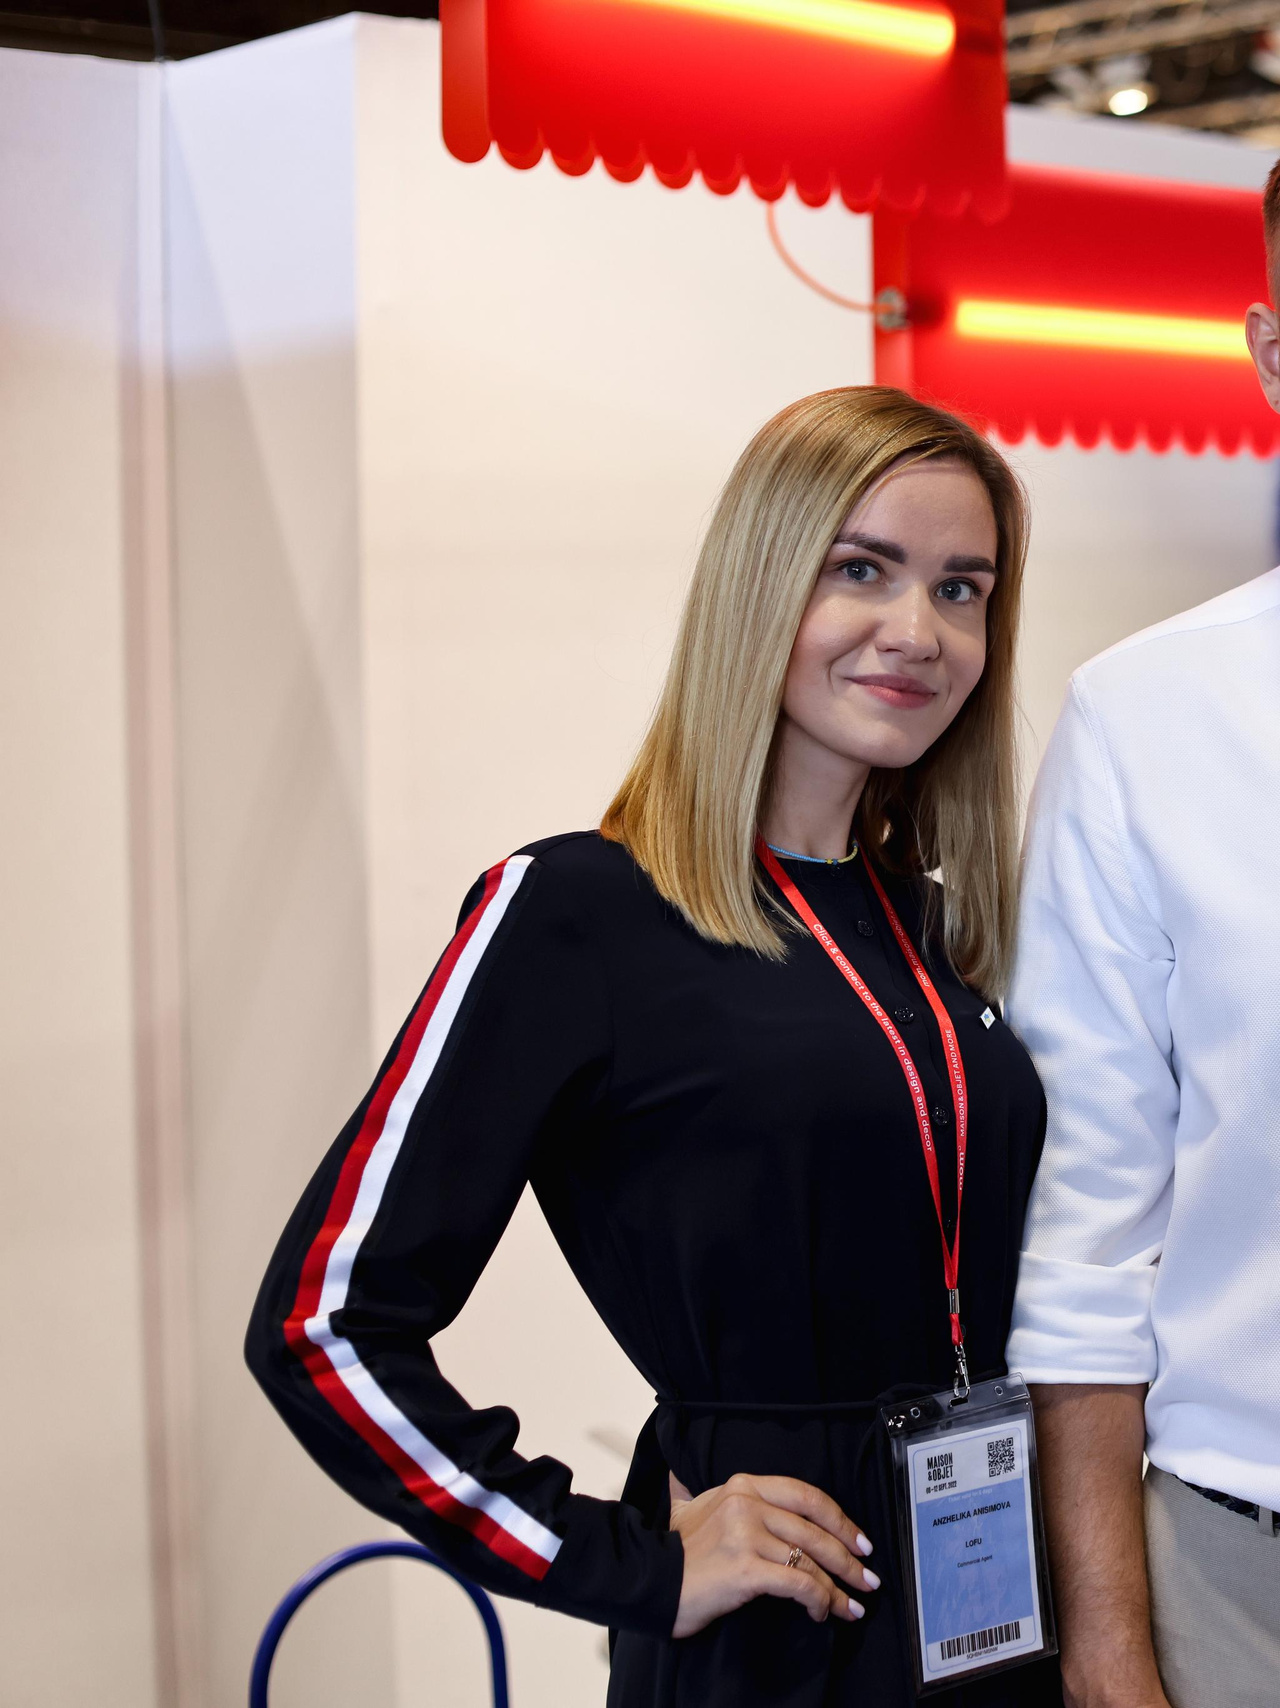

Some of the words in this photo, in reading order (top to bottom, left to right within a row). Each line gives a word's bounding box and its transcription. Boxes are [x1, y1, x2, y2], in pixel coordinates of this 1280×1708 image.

[813, 923, 833, 946] Click
[830, 946, 839, 955] &
[835, 955, 865, 990] connect
[862, 991, 872, 1001] to
[870, 1002, 883, 1017] the
[881, 1017, 901, 1044] latest
[945, 1029, 955, 1051] MORE
[897, 1046, 906, 1056] in
[950, 1051, 959, 1069] AND
[903, 1058, 921, 1094] design
[954, 1070, 963, 1095] OBJET
[916, 1096, 928, 1117] and
[921, 1119, 933, 1152] decor
[927, 1452, 953, 1470] MAISON
[927, 1464, 953, 1481] &OBJET
[932, 1510, 971, 1527] ANZHELIKA
[972, 1500, 1011, 1517] ANISIMOVA
[965, 1538, 982, 1548] LOFU
